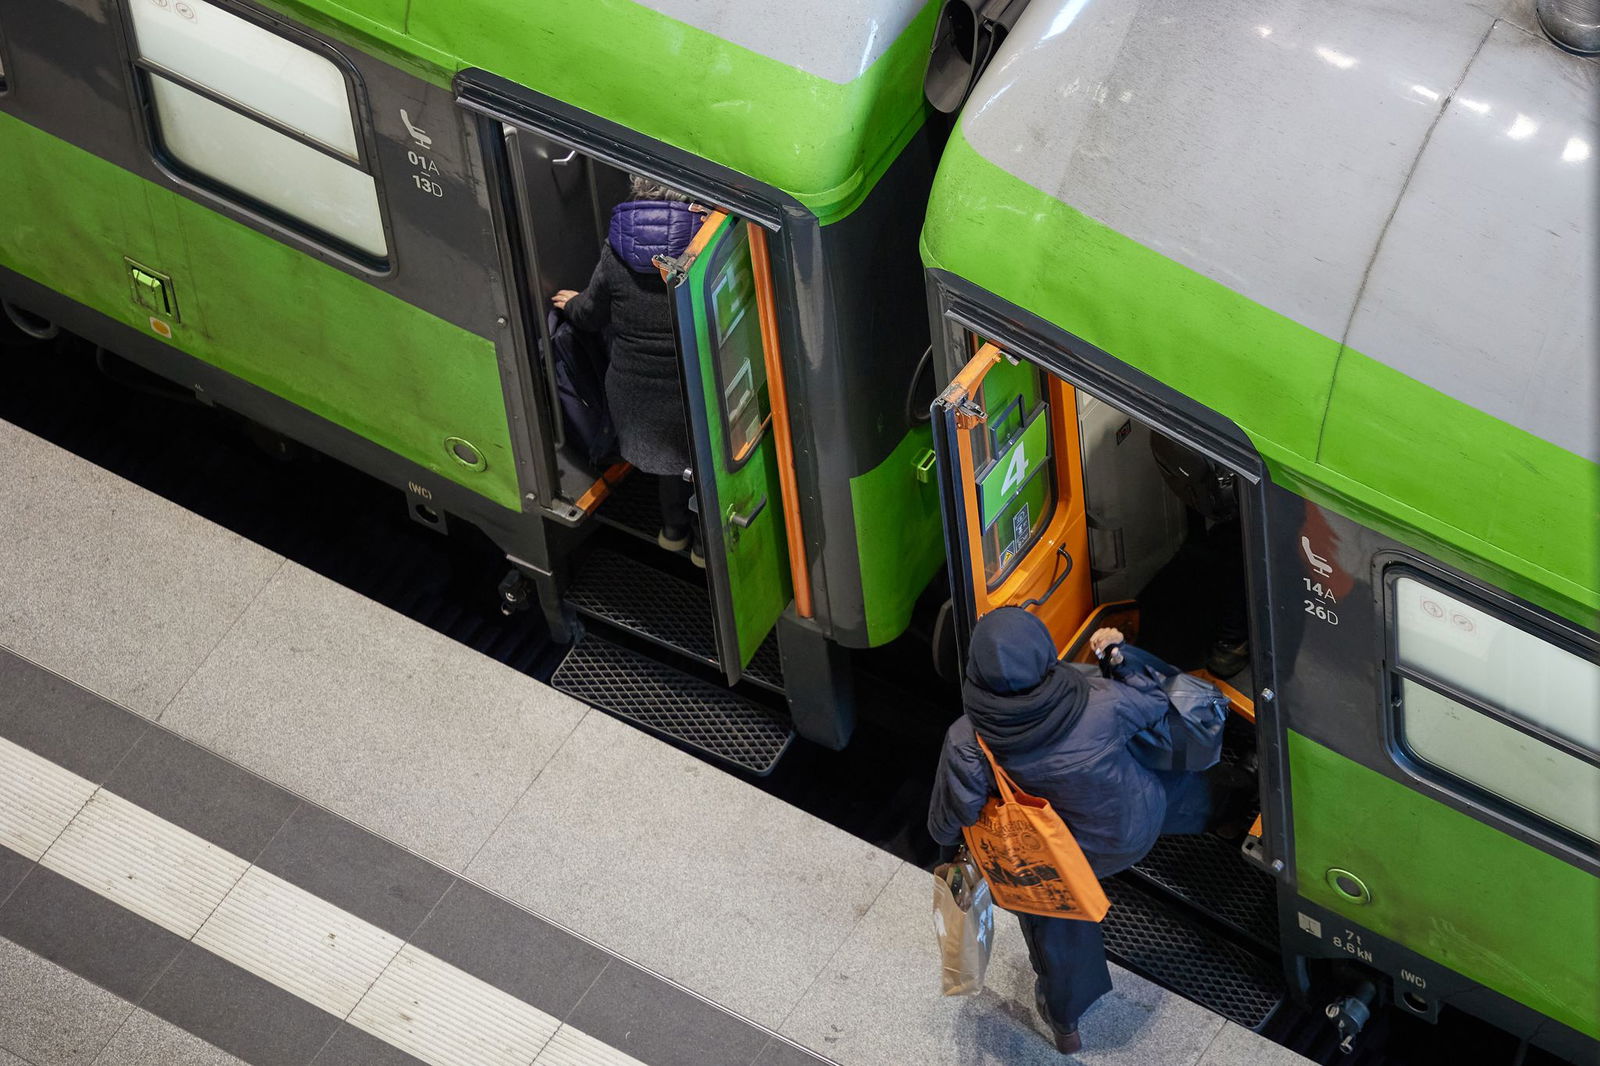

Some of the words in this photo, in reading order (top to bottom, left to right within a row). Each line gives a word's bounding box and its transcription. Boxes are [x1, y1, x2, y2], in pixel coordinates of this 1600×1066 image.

[407, 150, 440, 176] 01A
[412, 175, 443, 197] 13D
[1000, 440, 1029, 497] 4
[408, 480, 432, 500] (WC)
[1303, 577, 1337, 604] 14A
[1303, 599, 1339, 625] 26D
[1400, 968, 1426, 989] (WC)
